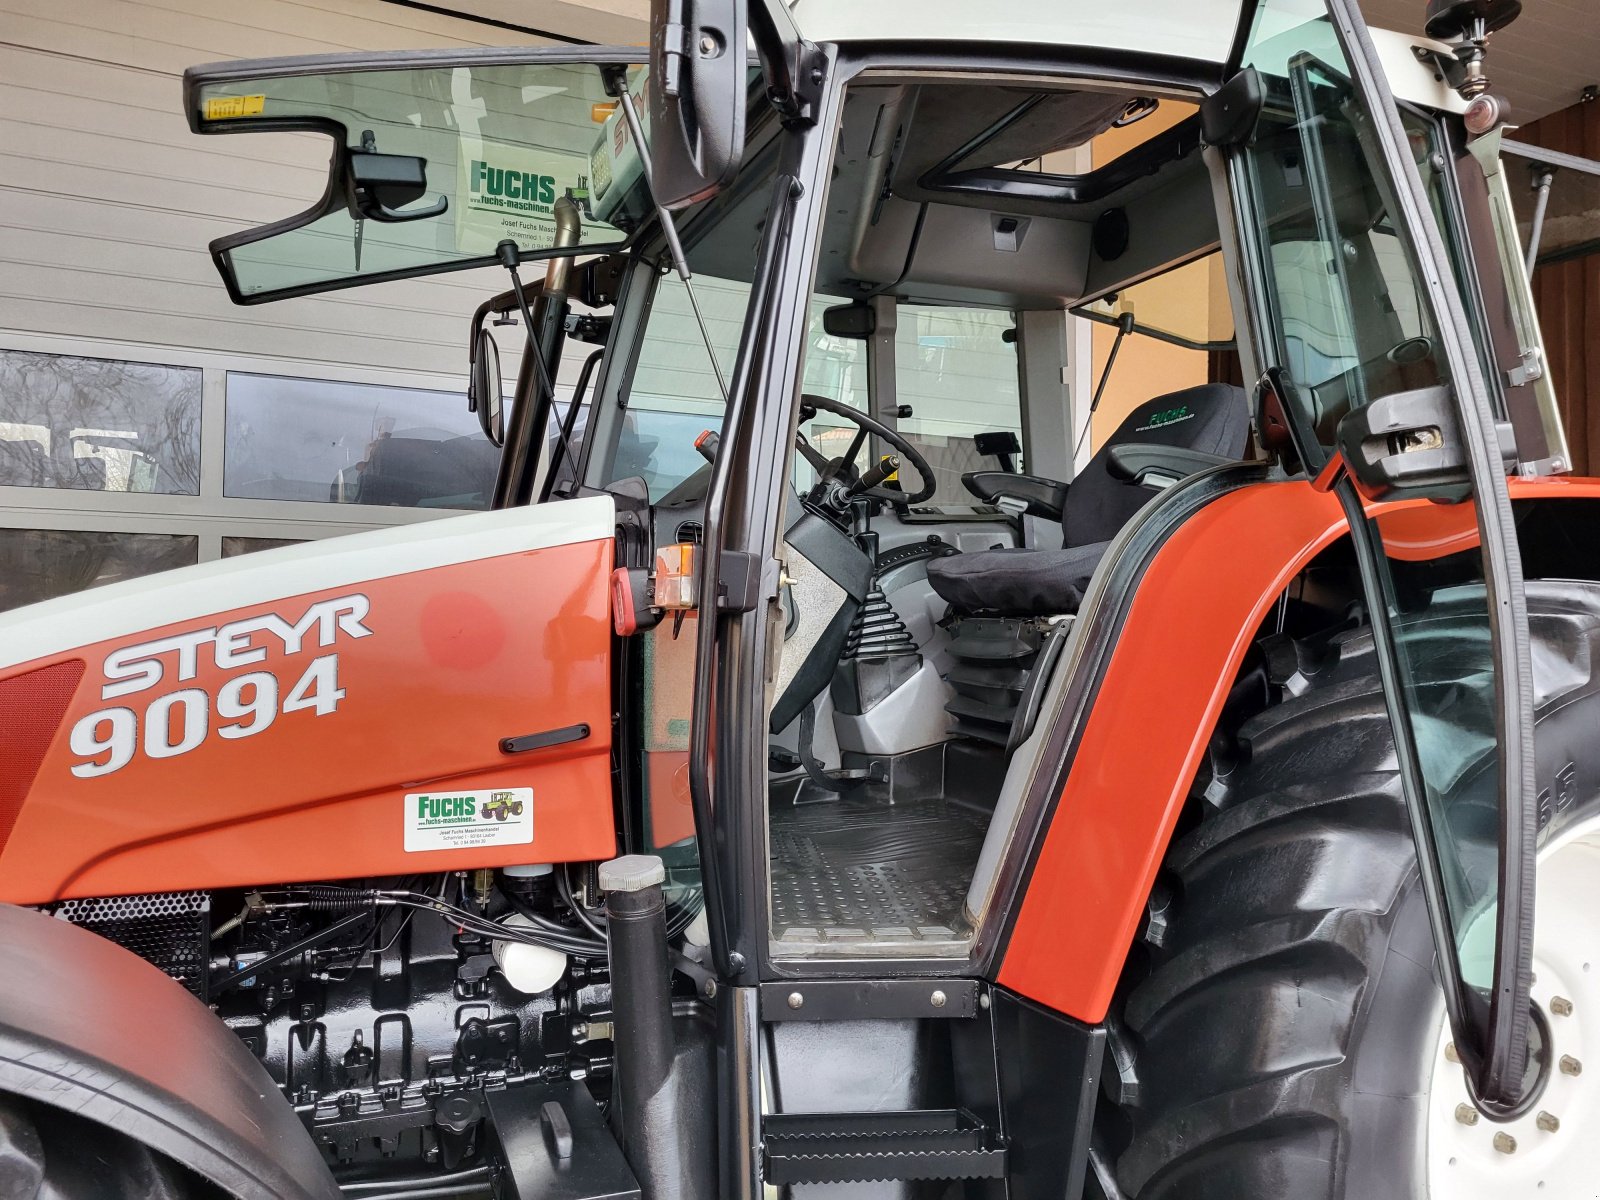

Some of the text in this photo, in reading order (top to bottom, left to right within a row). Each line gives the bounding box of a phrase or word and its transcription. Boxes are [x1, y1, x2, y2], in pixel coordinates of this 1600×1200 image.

[470, 160, 556, 204] FUCHS
[501, 218, 518, 228] Josef
[519, 220, 537, 232] Fuchs
[101, 592, 374, 700] STEYR
[69, 652, 347, 778] 9094
[418, 796, 476, 819] FUCHS
